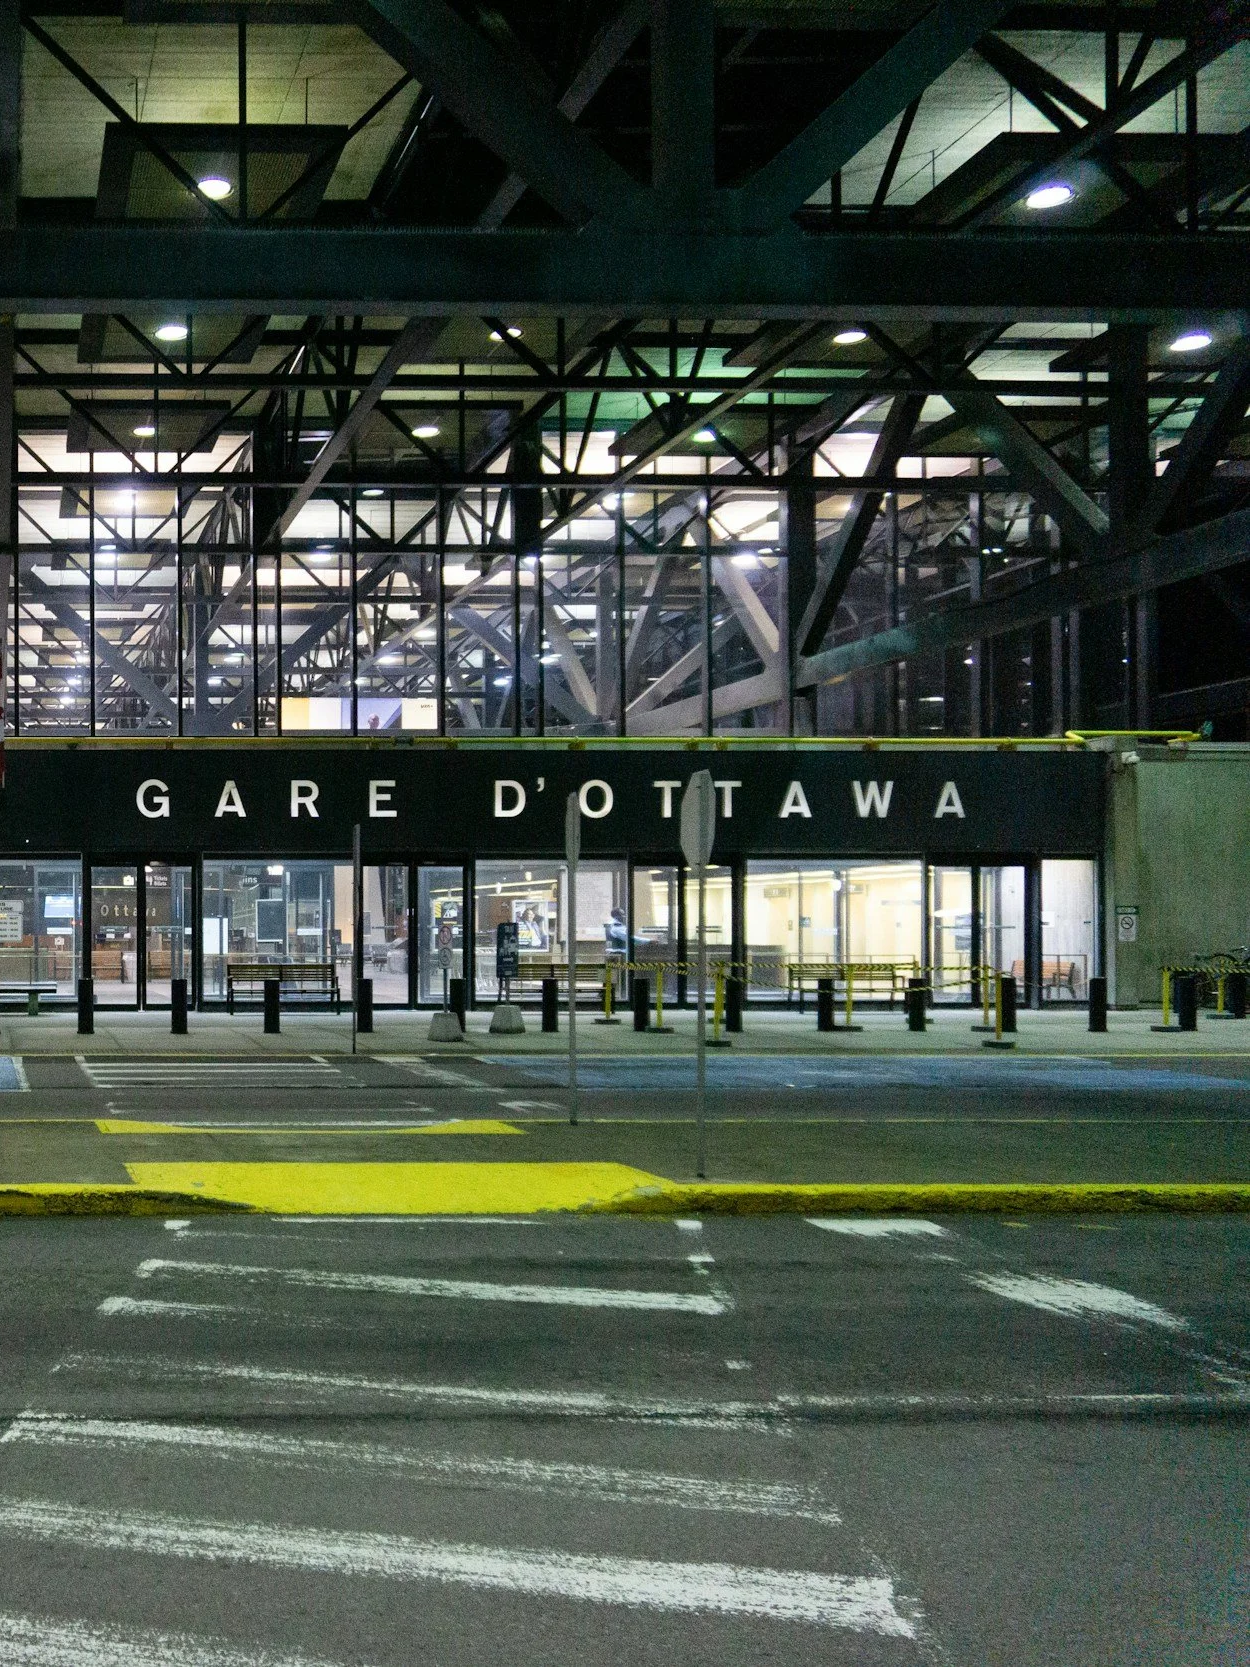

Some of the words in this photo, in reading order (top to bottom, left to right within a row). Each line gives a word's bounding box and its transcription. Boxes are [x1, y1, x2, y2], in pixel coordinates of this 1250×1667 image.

[135, 778, 398, 819] GARE
[493, 777, 966, 819] D'OTTAWA
[100, 904, 156, 917] Ottaa
